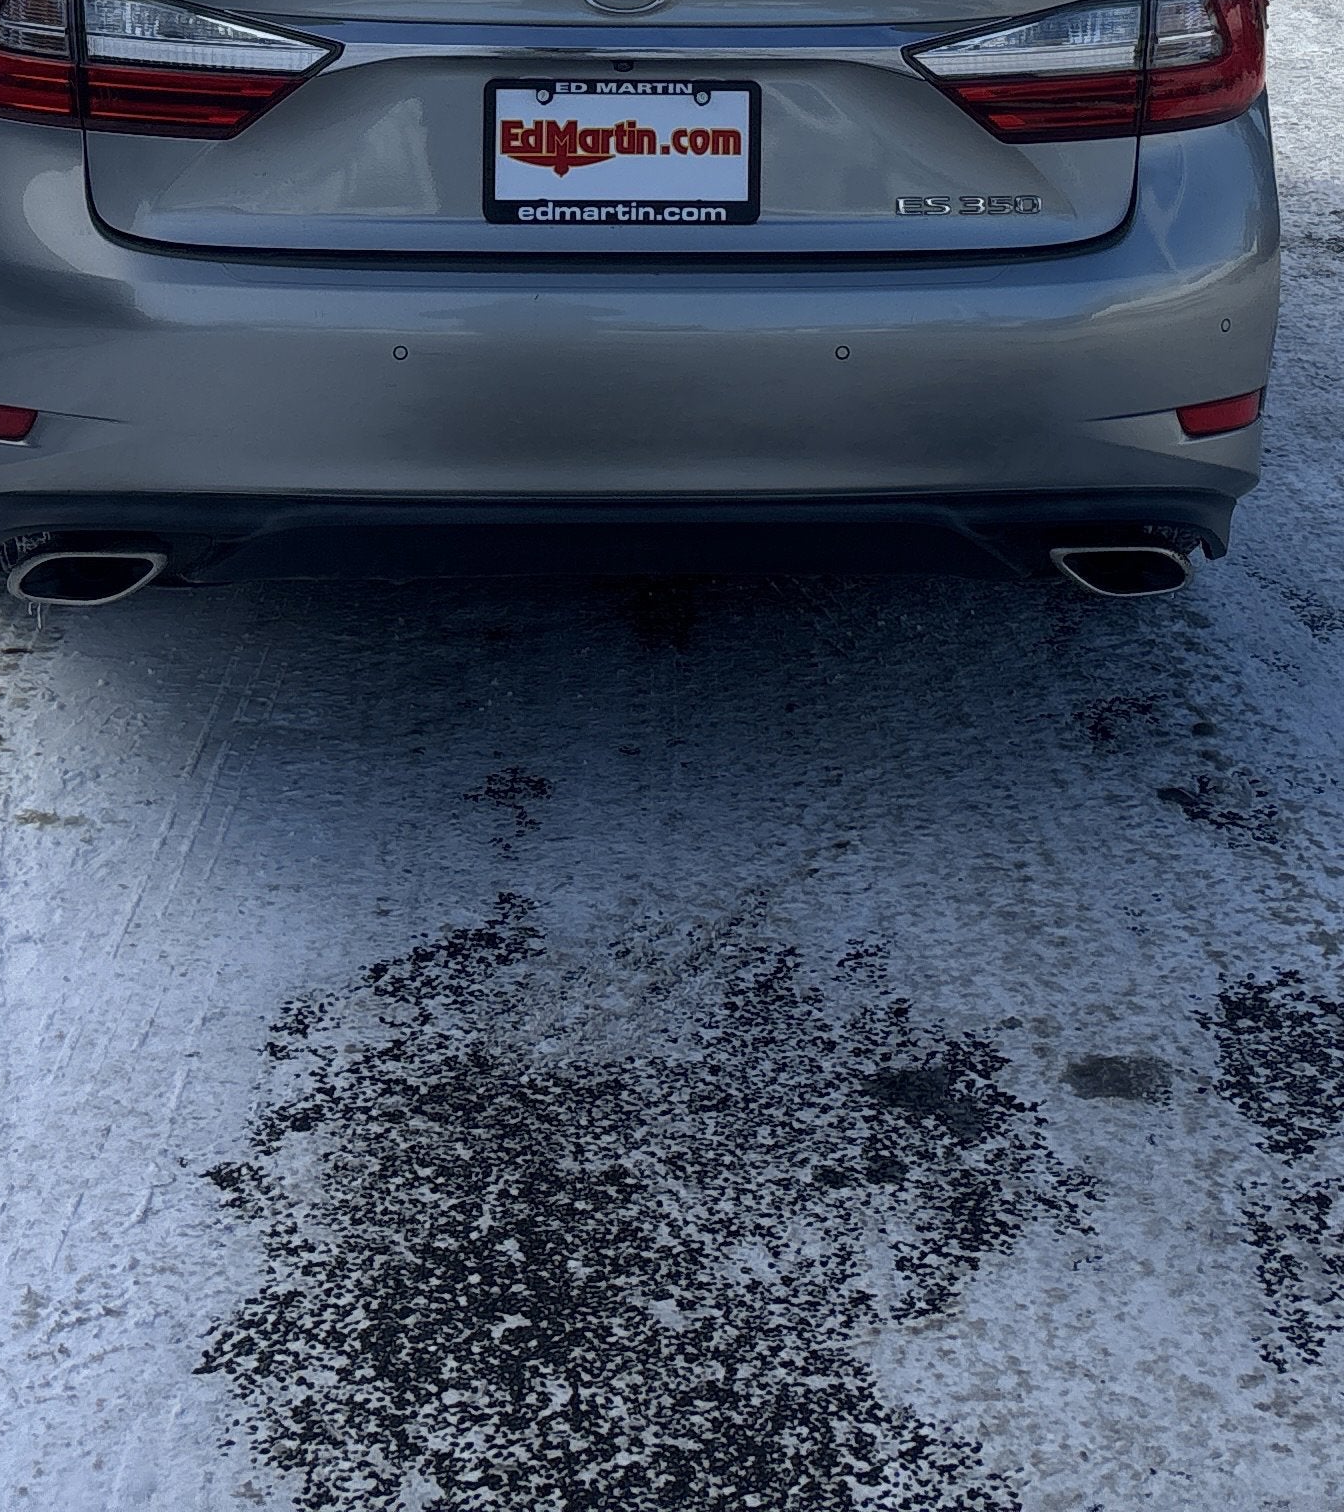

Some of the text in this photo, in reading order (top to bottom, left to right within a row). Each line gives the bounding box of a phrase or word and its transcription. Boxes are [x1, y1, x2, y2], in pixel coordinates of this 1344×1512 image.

[555, 82, 693, 94] ED MARTIN
[499, 119, 742, 157] EdMartin.com
[517, 202, 727, 222] edmartin.com
[896, 195, 1043, 216] ES 350
